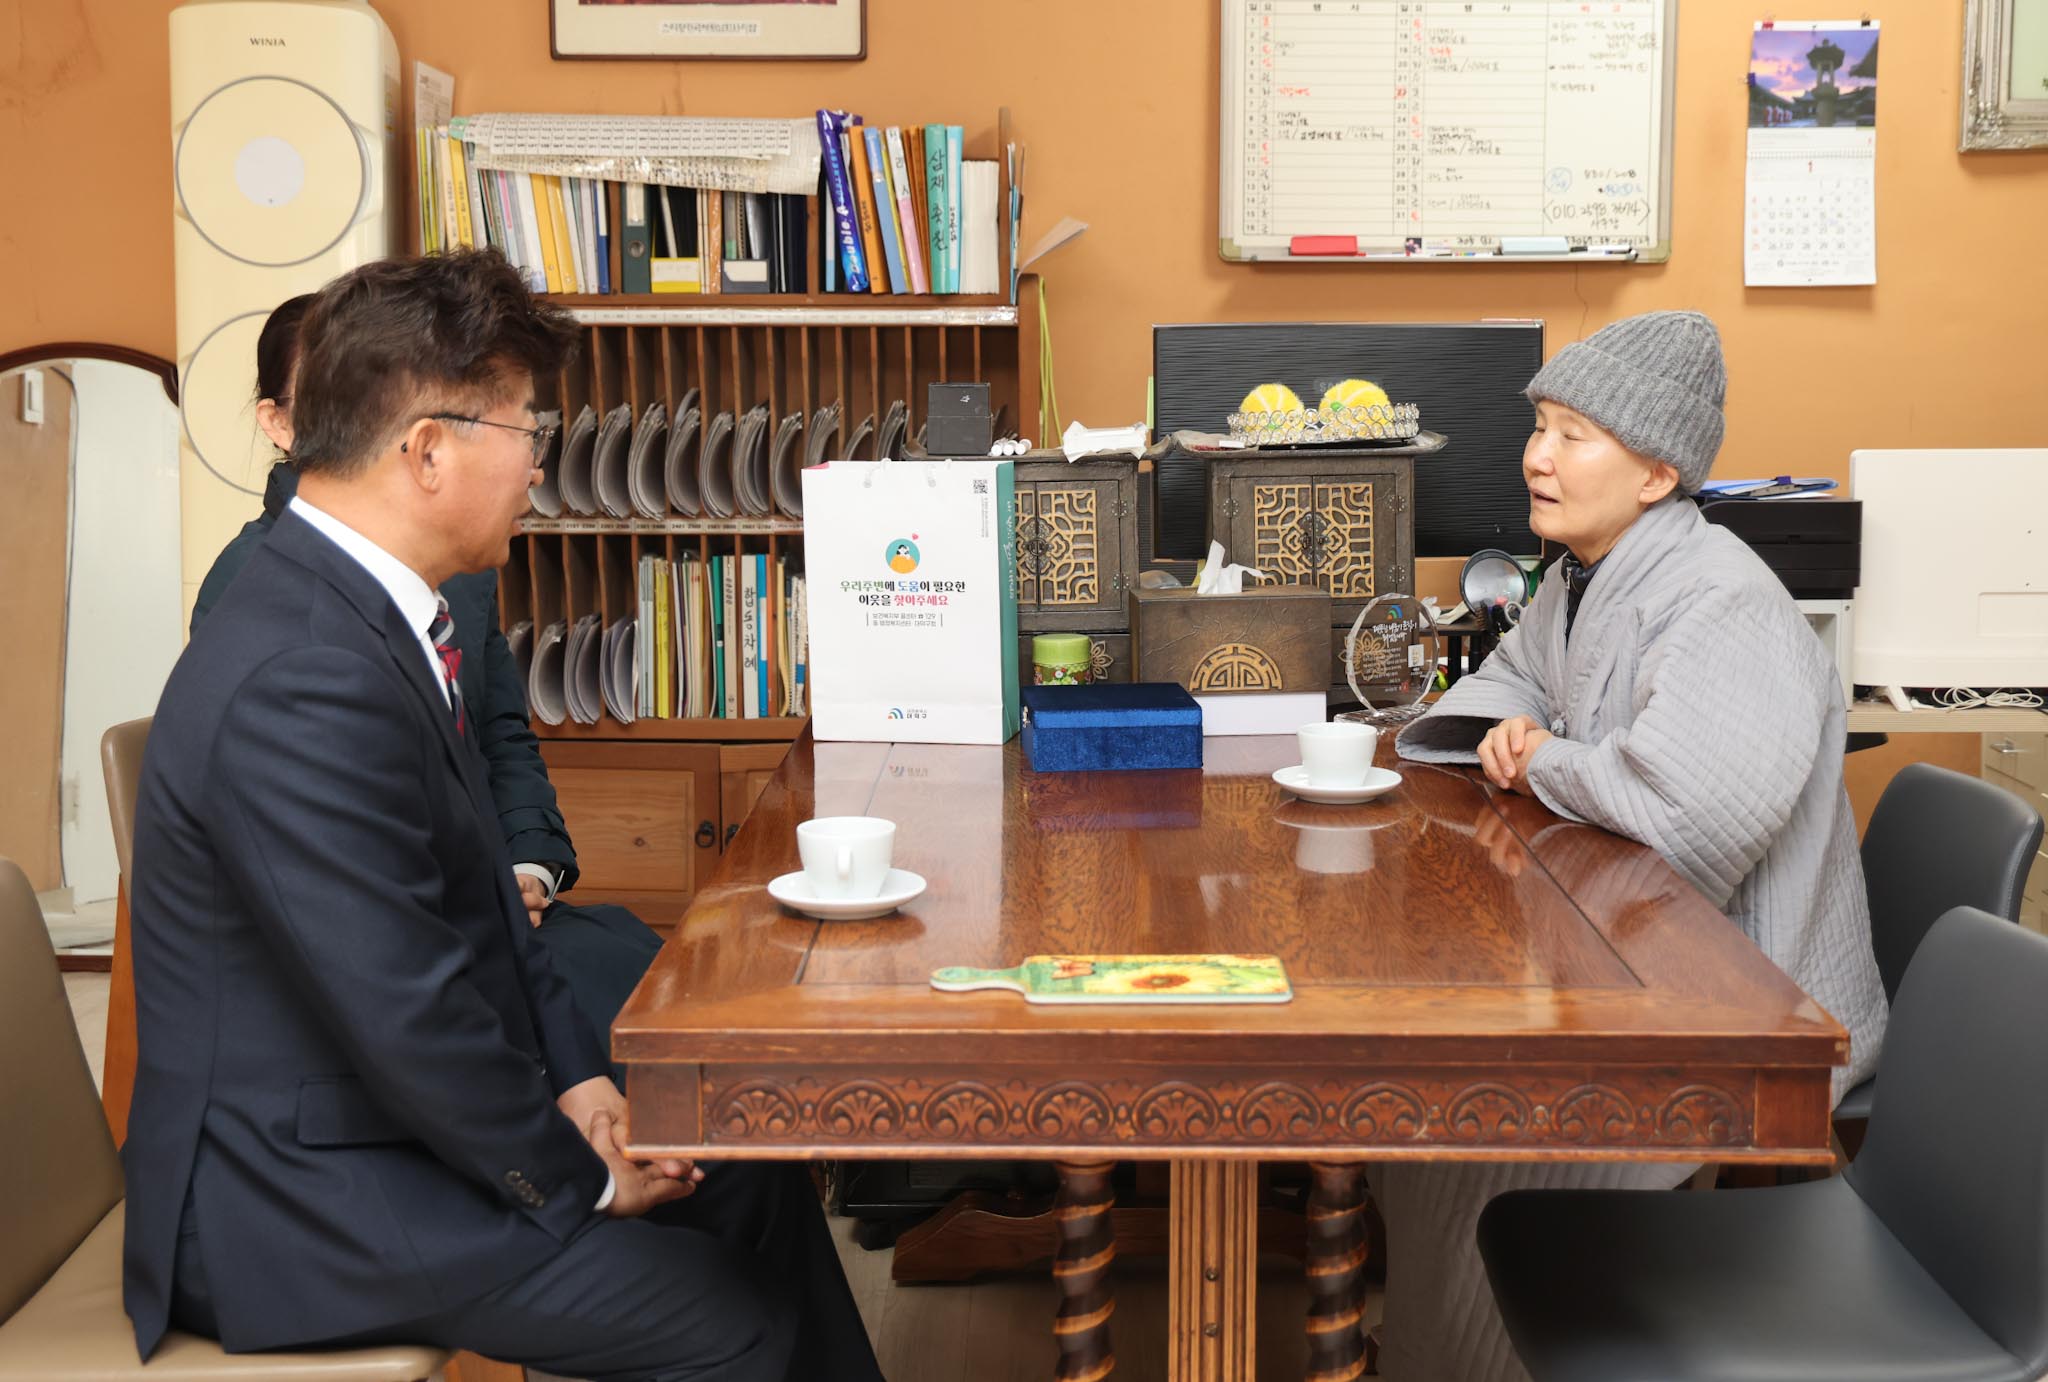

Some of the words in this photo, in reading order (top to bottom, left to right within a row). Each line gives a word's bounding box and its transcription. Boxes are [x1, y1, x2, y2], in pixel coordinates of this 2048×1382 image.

[250, 37, 286, 47] WINIA
[840, 581, 894, 592] 우리주변에
[898, 581, 930, 592] 도움이
[933, 581, 965, 592] 필요한
[859, 594, 891, 606] 이웃을
[894, 594, 948, 606] 찾아주세요
